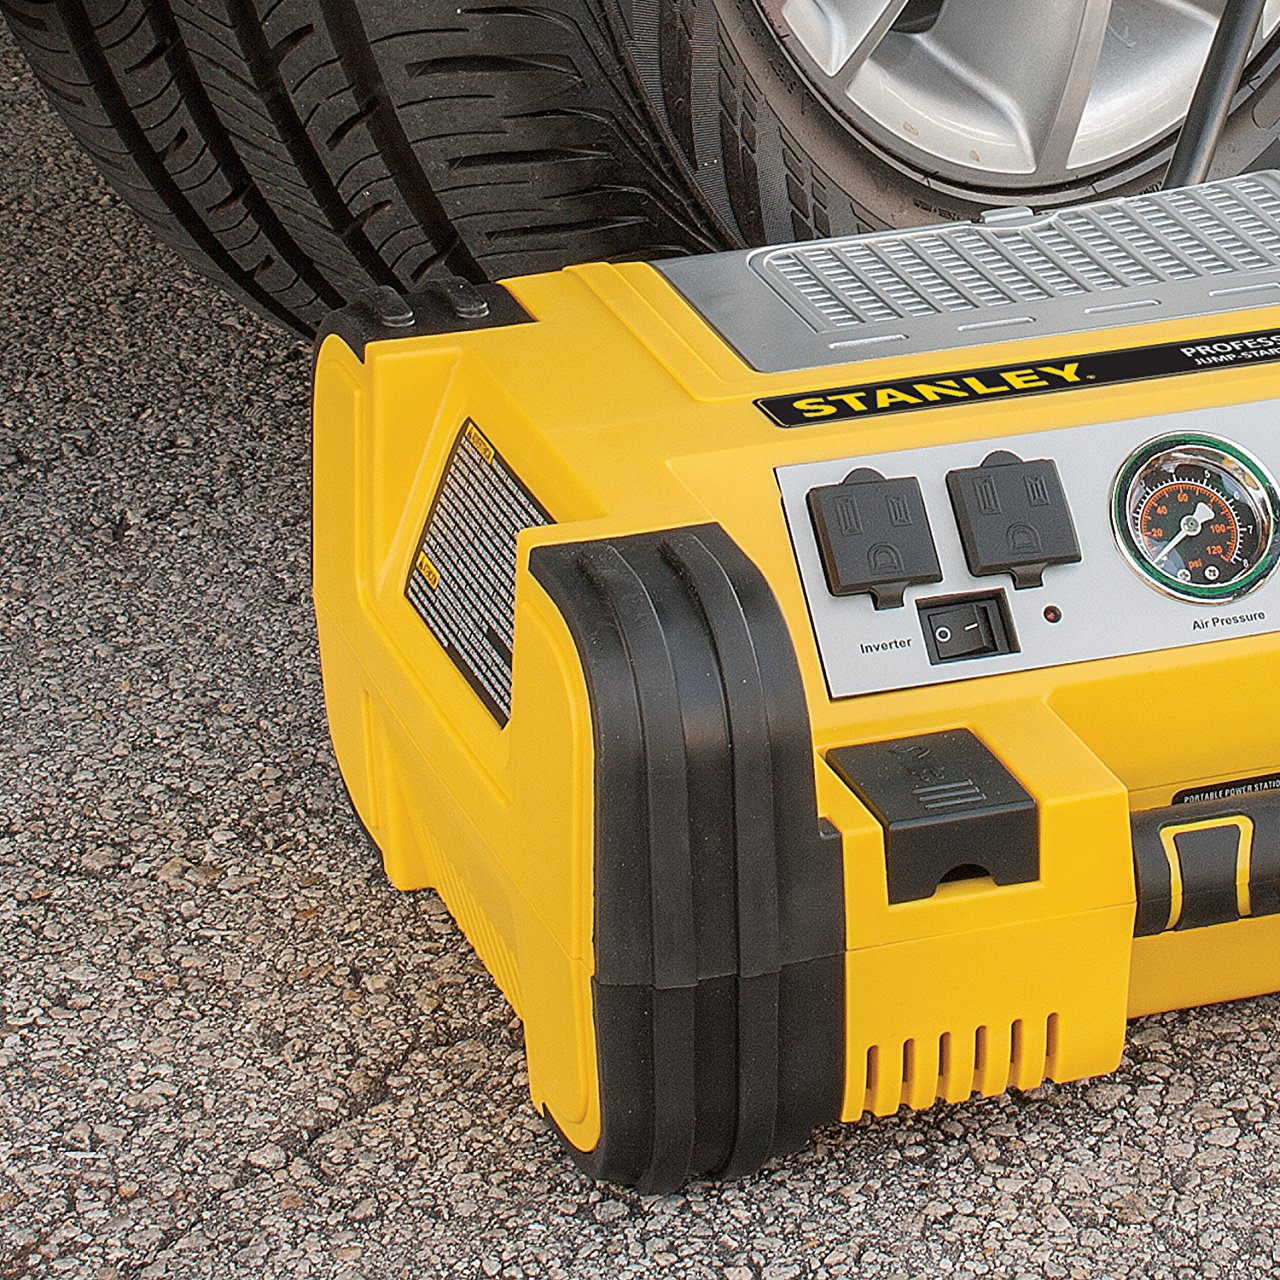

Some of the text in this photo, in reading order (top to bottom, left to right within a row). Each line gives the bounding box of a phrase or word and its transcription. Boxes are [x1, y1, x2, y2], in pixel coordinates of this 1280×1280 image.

[792, 362, 1082, 419] STANLEY
[1177, 493, 1189, 502] 60
[1156, 506, 1168, 515] 40
[1152, 528, 1163, 538] 20
[1210, 524, 1226, 534] 100
[1247, 525, 1253, 534] 7
[1206, 545, 1223, 555] 120
[1188, 559, 1203, 570] psi
[1242, 558, 1249, 567] 8
[1191, 610, 1266, 631] Air Pressure
[859, 637, 913, 655] Inverter
[1183, 789, 1224, 803] PORTABLE
[1225, 784, 1253, 797] POWER
